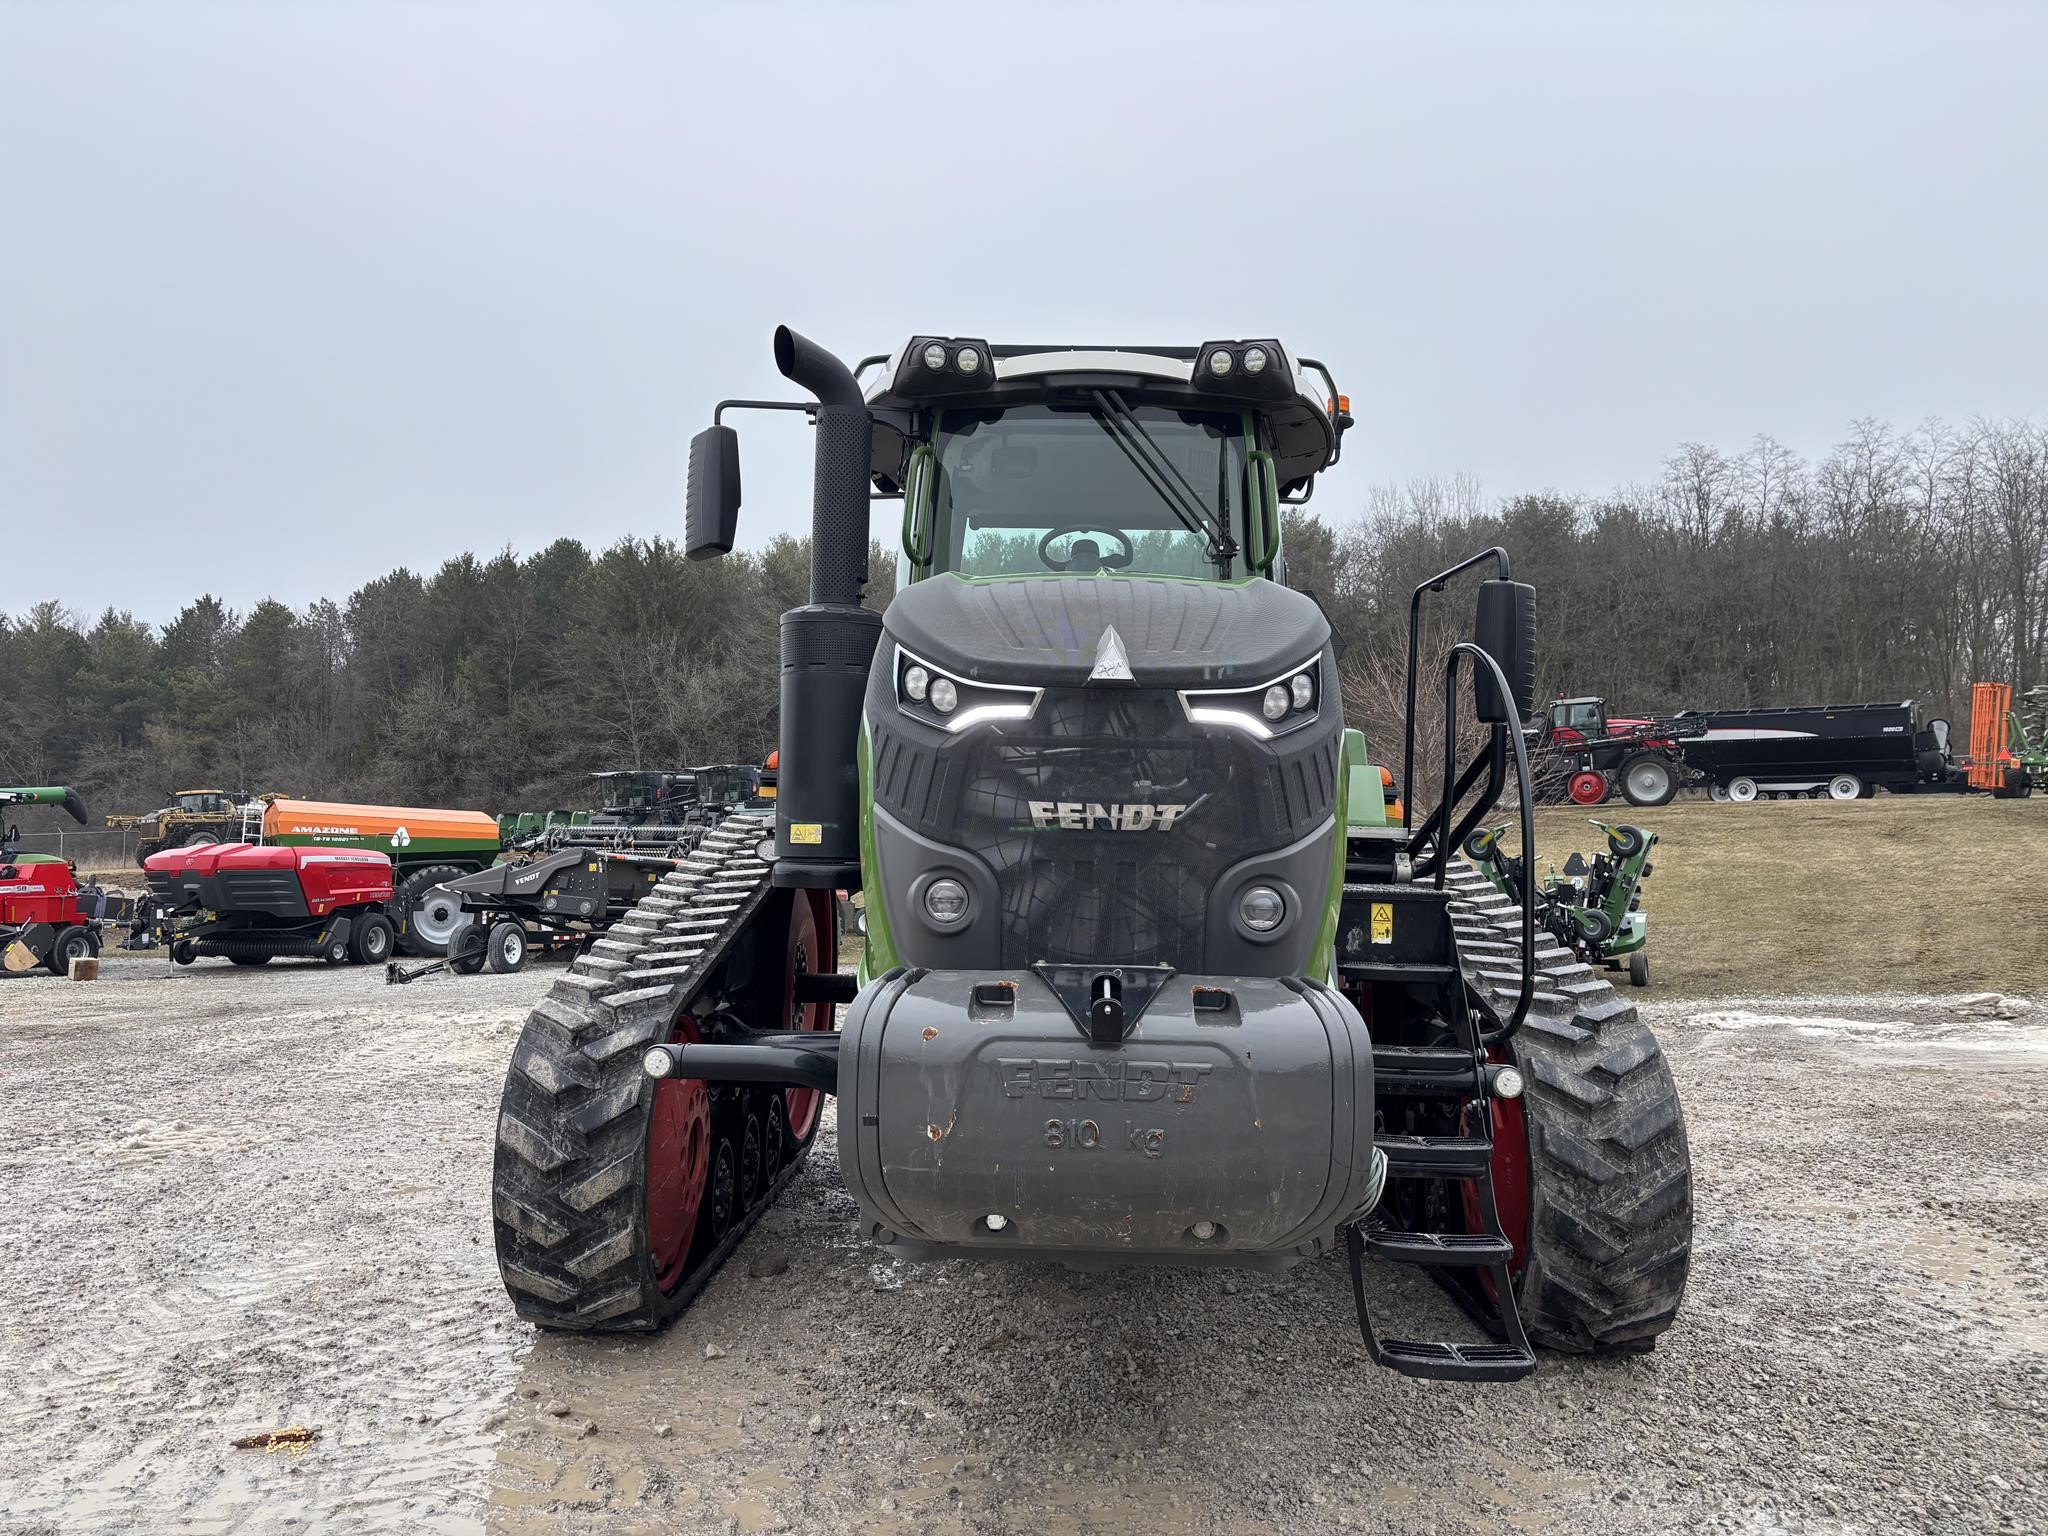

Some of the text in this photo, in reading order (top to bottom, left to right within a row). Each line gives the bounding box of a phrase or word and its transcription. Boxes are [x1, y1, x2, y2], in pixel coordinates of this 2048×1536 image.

[291, 826, 358, 834] AMAZONE
[1028, 800, 1187, 832] FENDT
[515, 871, 540, 886] FENDT
[997, 1057, 1214, 1104] FENDT
[1044, 1118, 1166, 1160] 810 kg
